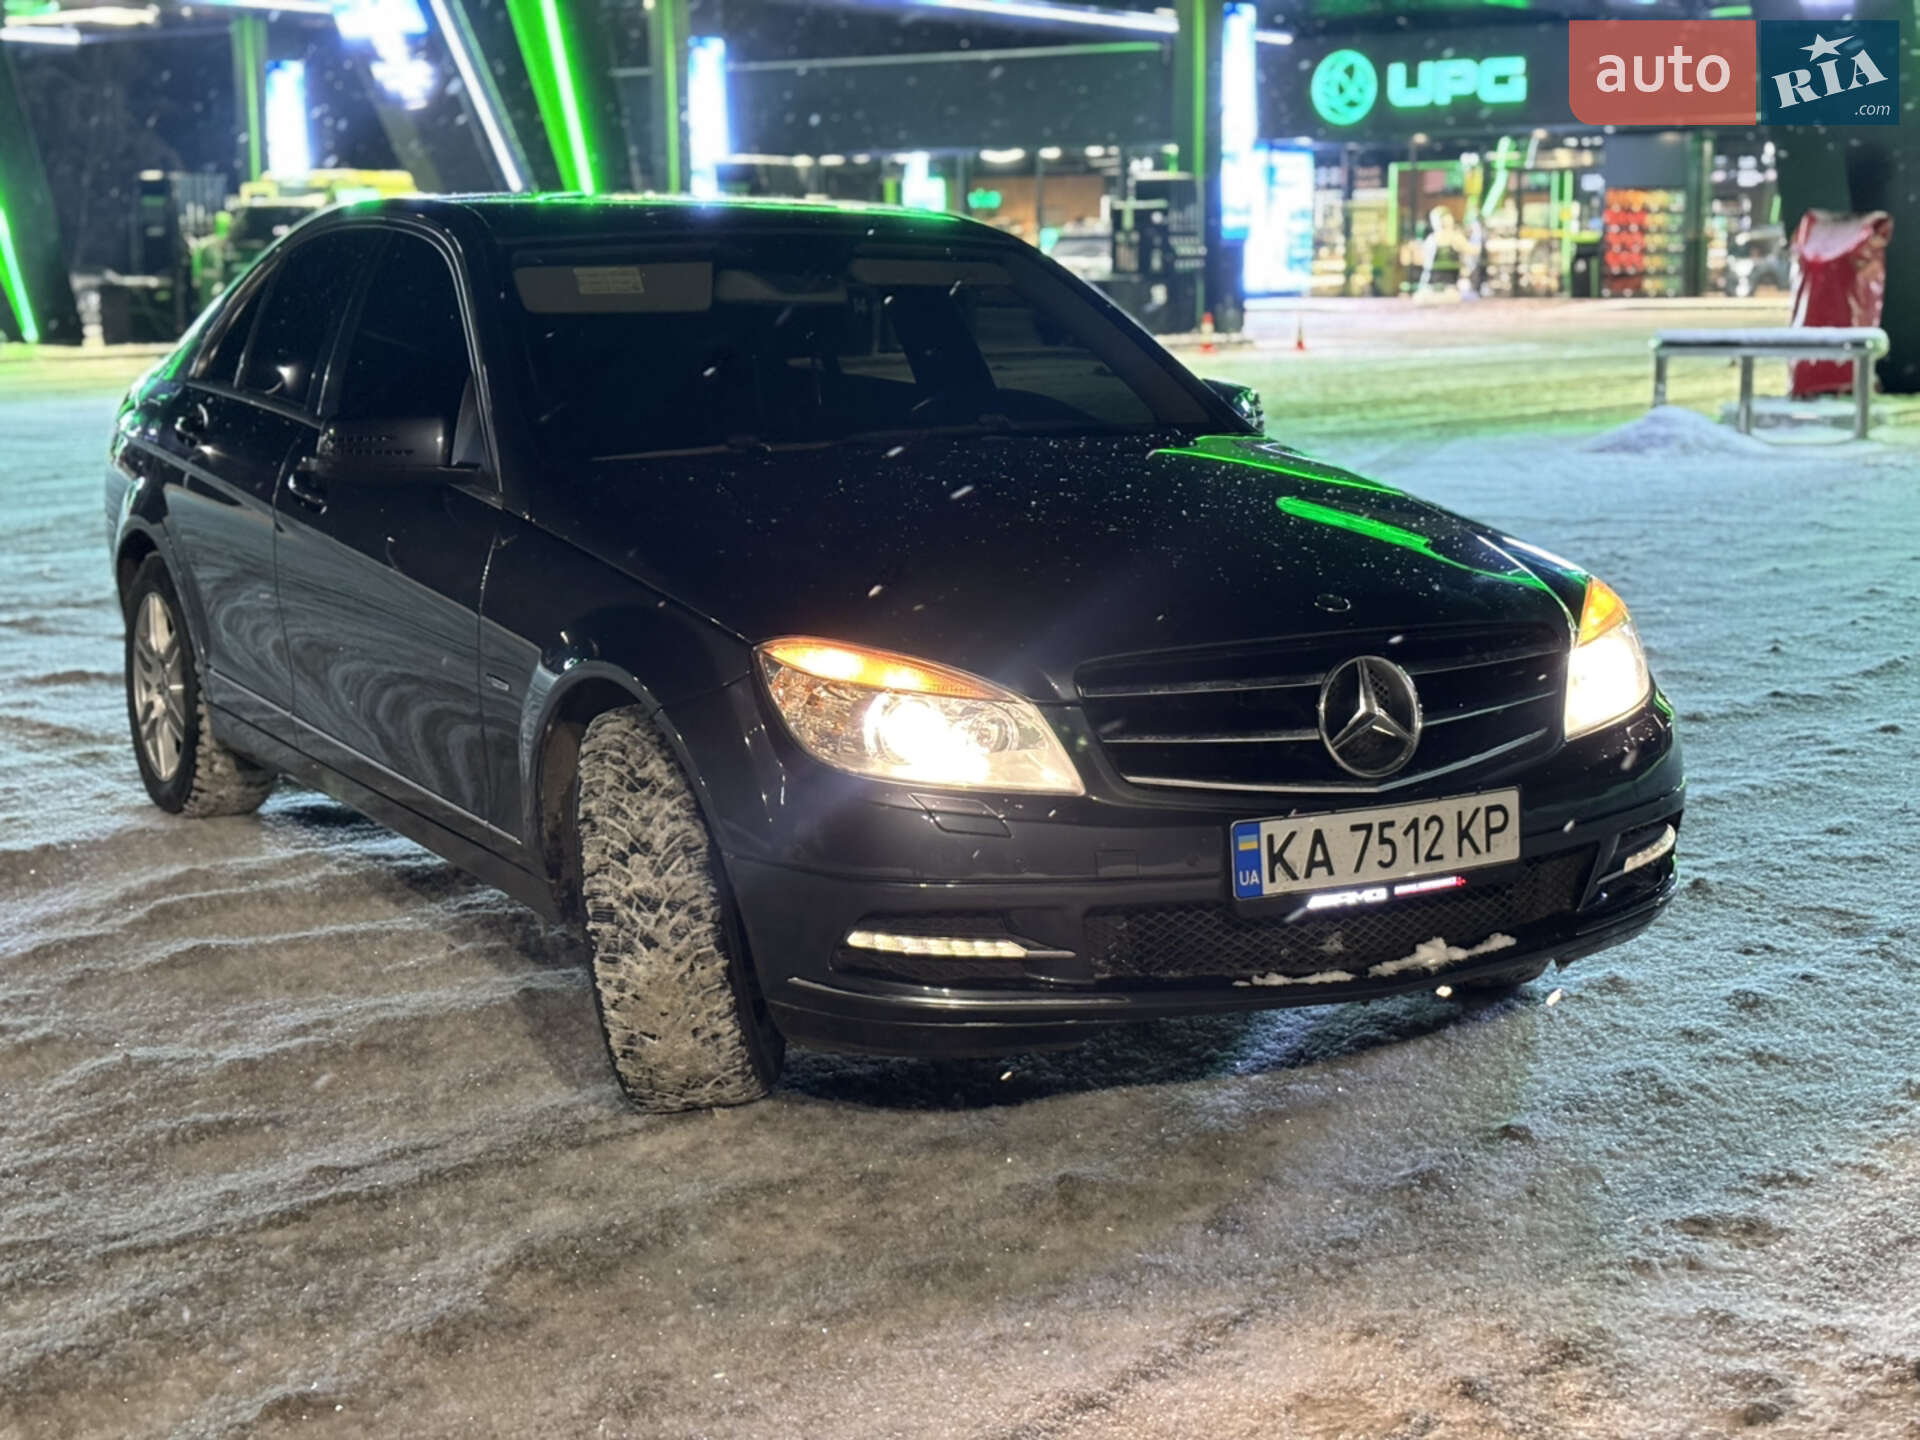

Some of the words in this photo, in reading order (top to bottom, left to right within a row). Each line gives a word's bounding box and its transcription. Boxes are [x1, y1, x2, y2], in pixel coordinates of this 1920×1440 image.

[1387, 56, 1528, 107] UPG
[1267, 829, 1335, 883] KA
[1350, 815, 1444, 873] 7512
[1458, 804, 1509, 857] KP
[1239, 871, 1260, 886] UA
